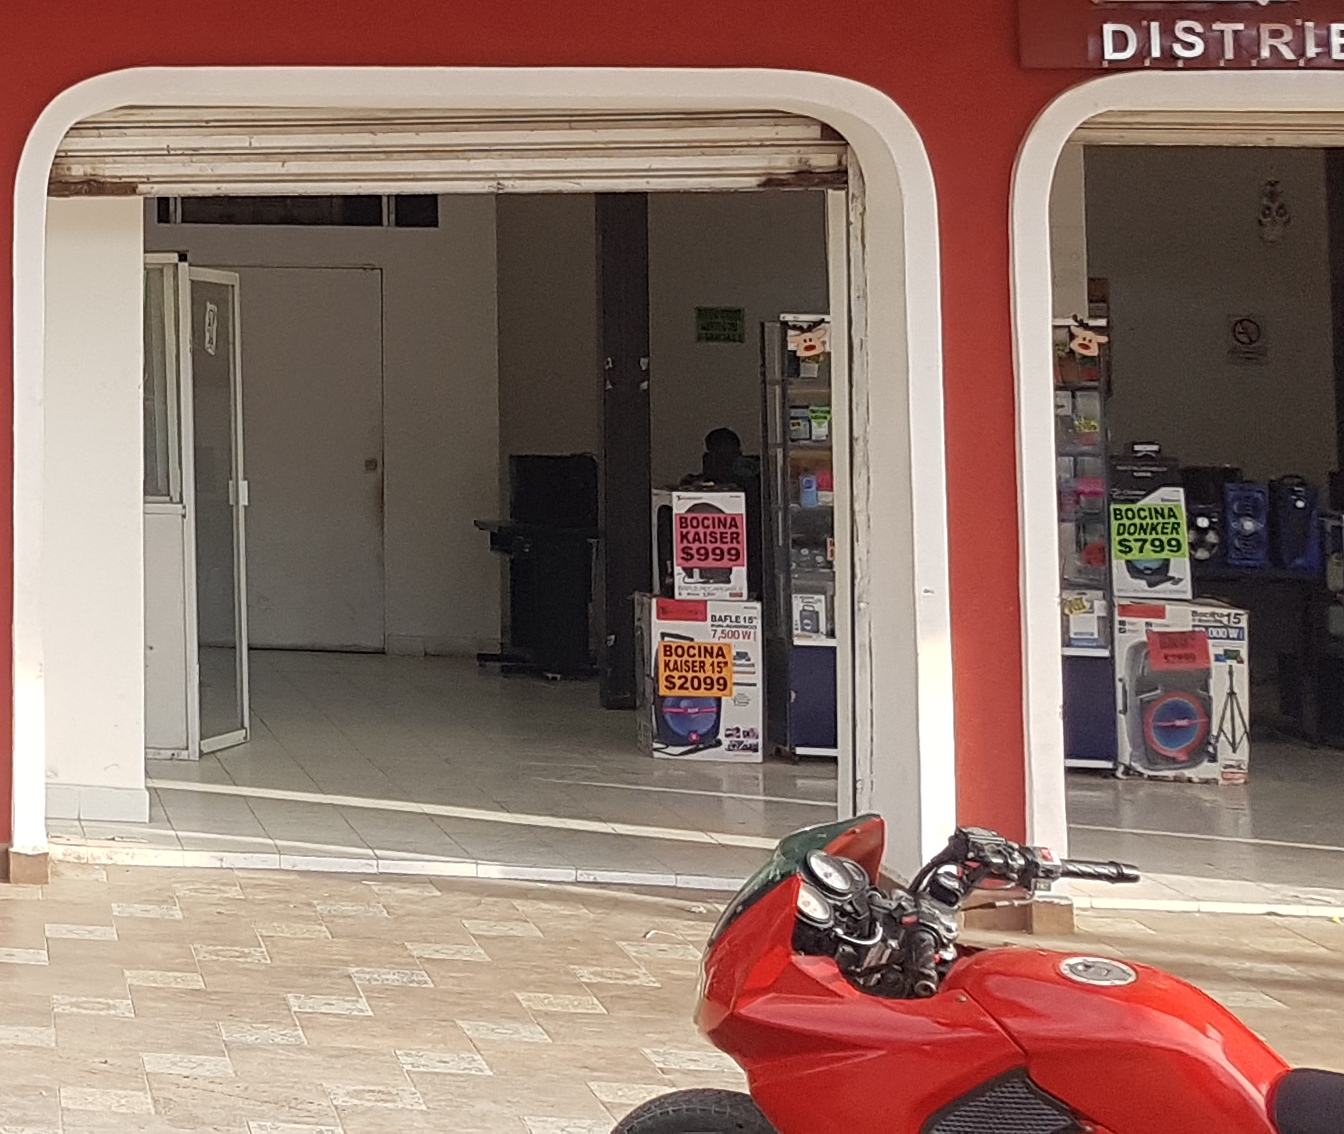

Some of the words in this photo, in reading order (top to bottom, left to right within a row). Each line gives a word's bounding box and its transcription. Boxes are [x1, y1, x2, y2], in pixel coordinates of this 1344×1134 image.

[1113, 507, 1178, 521] BOCINA
[679, 516, 739, 530] BOCINA
[1117, 522, 1181, 537] DONKER
[679, 531, 741, 545] KAISER
[1117, 537, 1182, 556] $799
[680, 546, 741, 563] $999
[663, 644, 726, 659] BOCINA
[663, 659, 706, 674] KAISER
[664, 675, 728, 692] $2099
